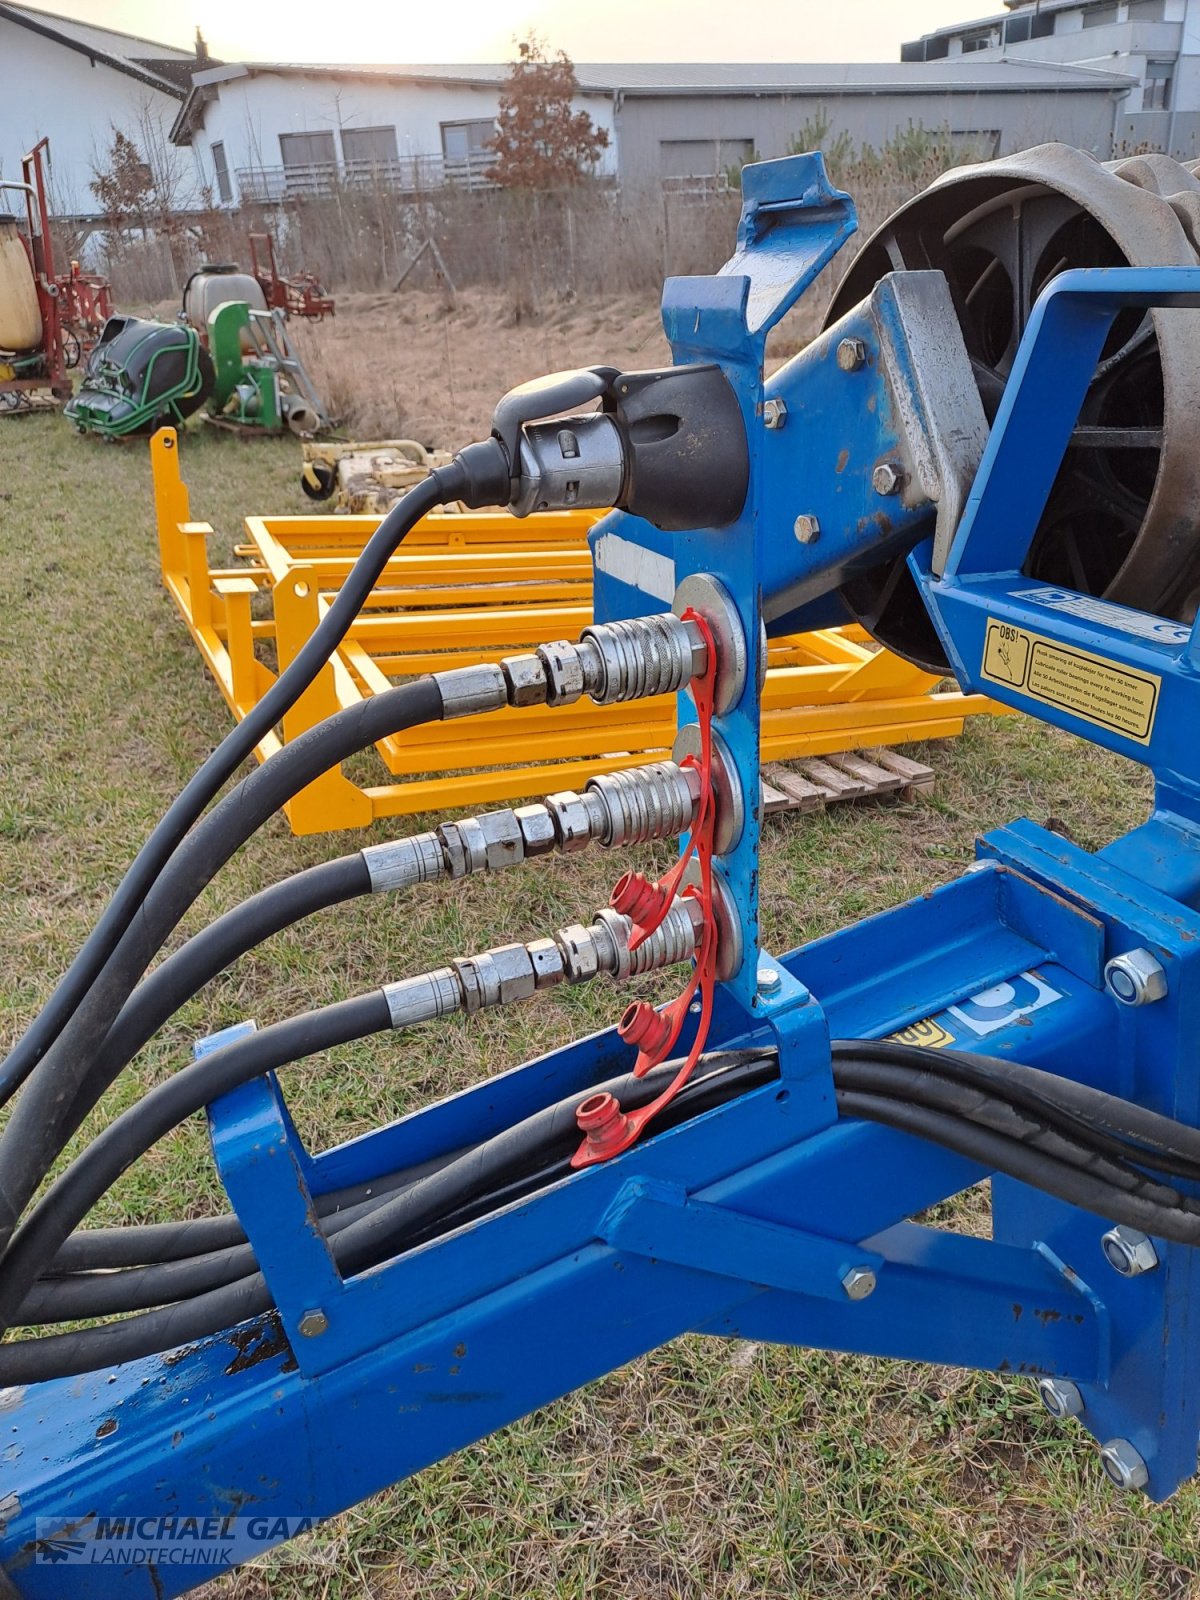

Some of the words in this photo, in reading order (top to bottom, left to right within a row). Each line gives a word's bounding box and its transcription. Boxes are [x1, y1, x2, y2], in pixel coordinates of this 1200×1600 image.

[999, 625, 1019, 643] OBS!
[1090, 680, 1103, 690] every
[1110, 688, 1131, 701] working
